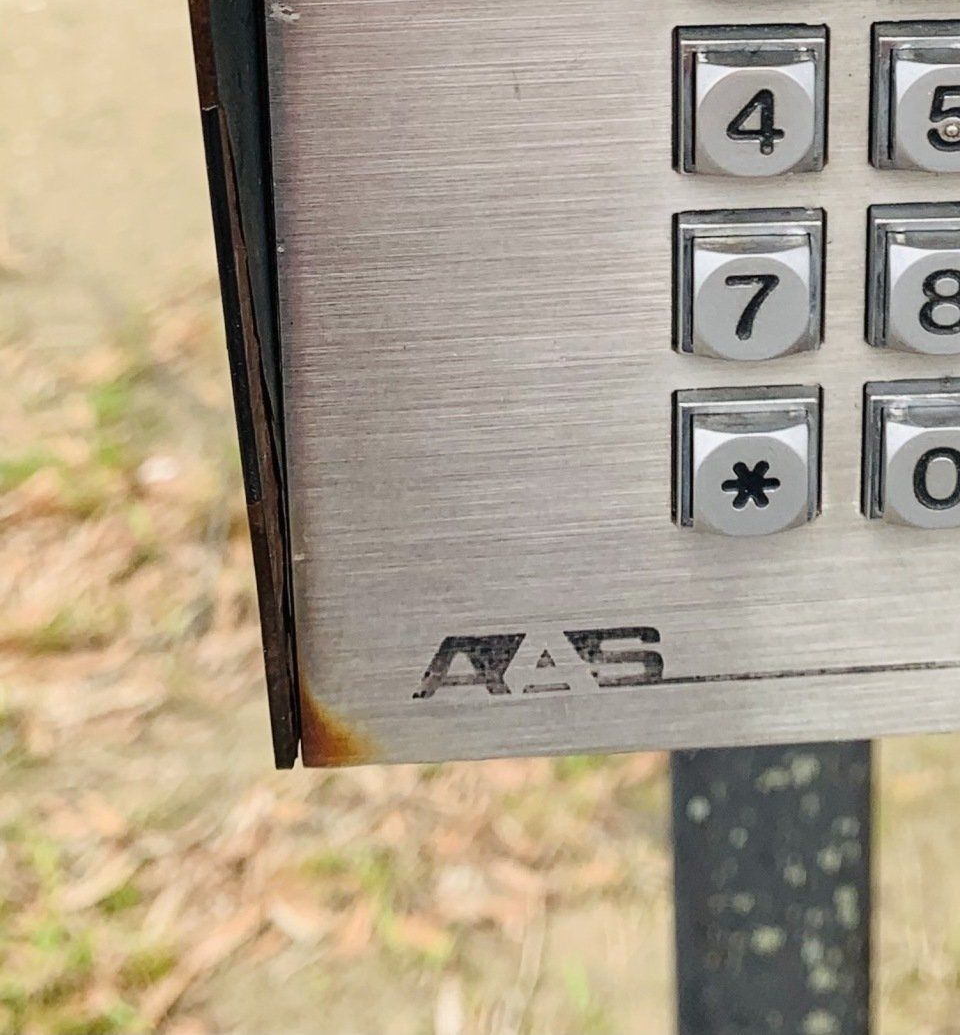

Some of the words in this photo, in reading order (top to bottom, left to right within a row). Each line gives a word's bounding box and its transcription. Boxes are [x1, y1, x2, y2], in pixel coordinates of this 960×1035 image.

[726, 89, 785, 155] 4
[725, 274, 780, 340] 7
[412, 626, 665, 698] AAS
